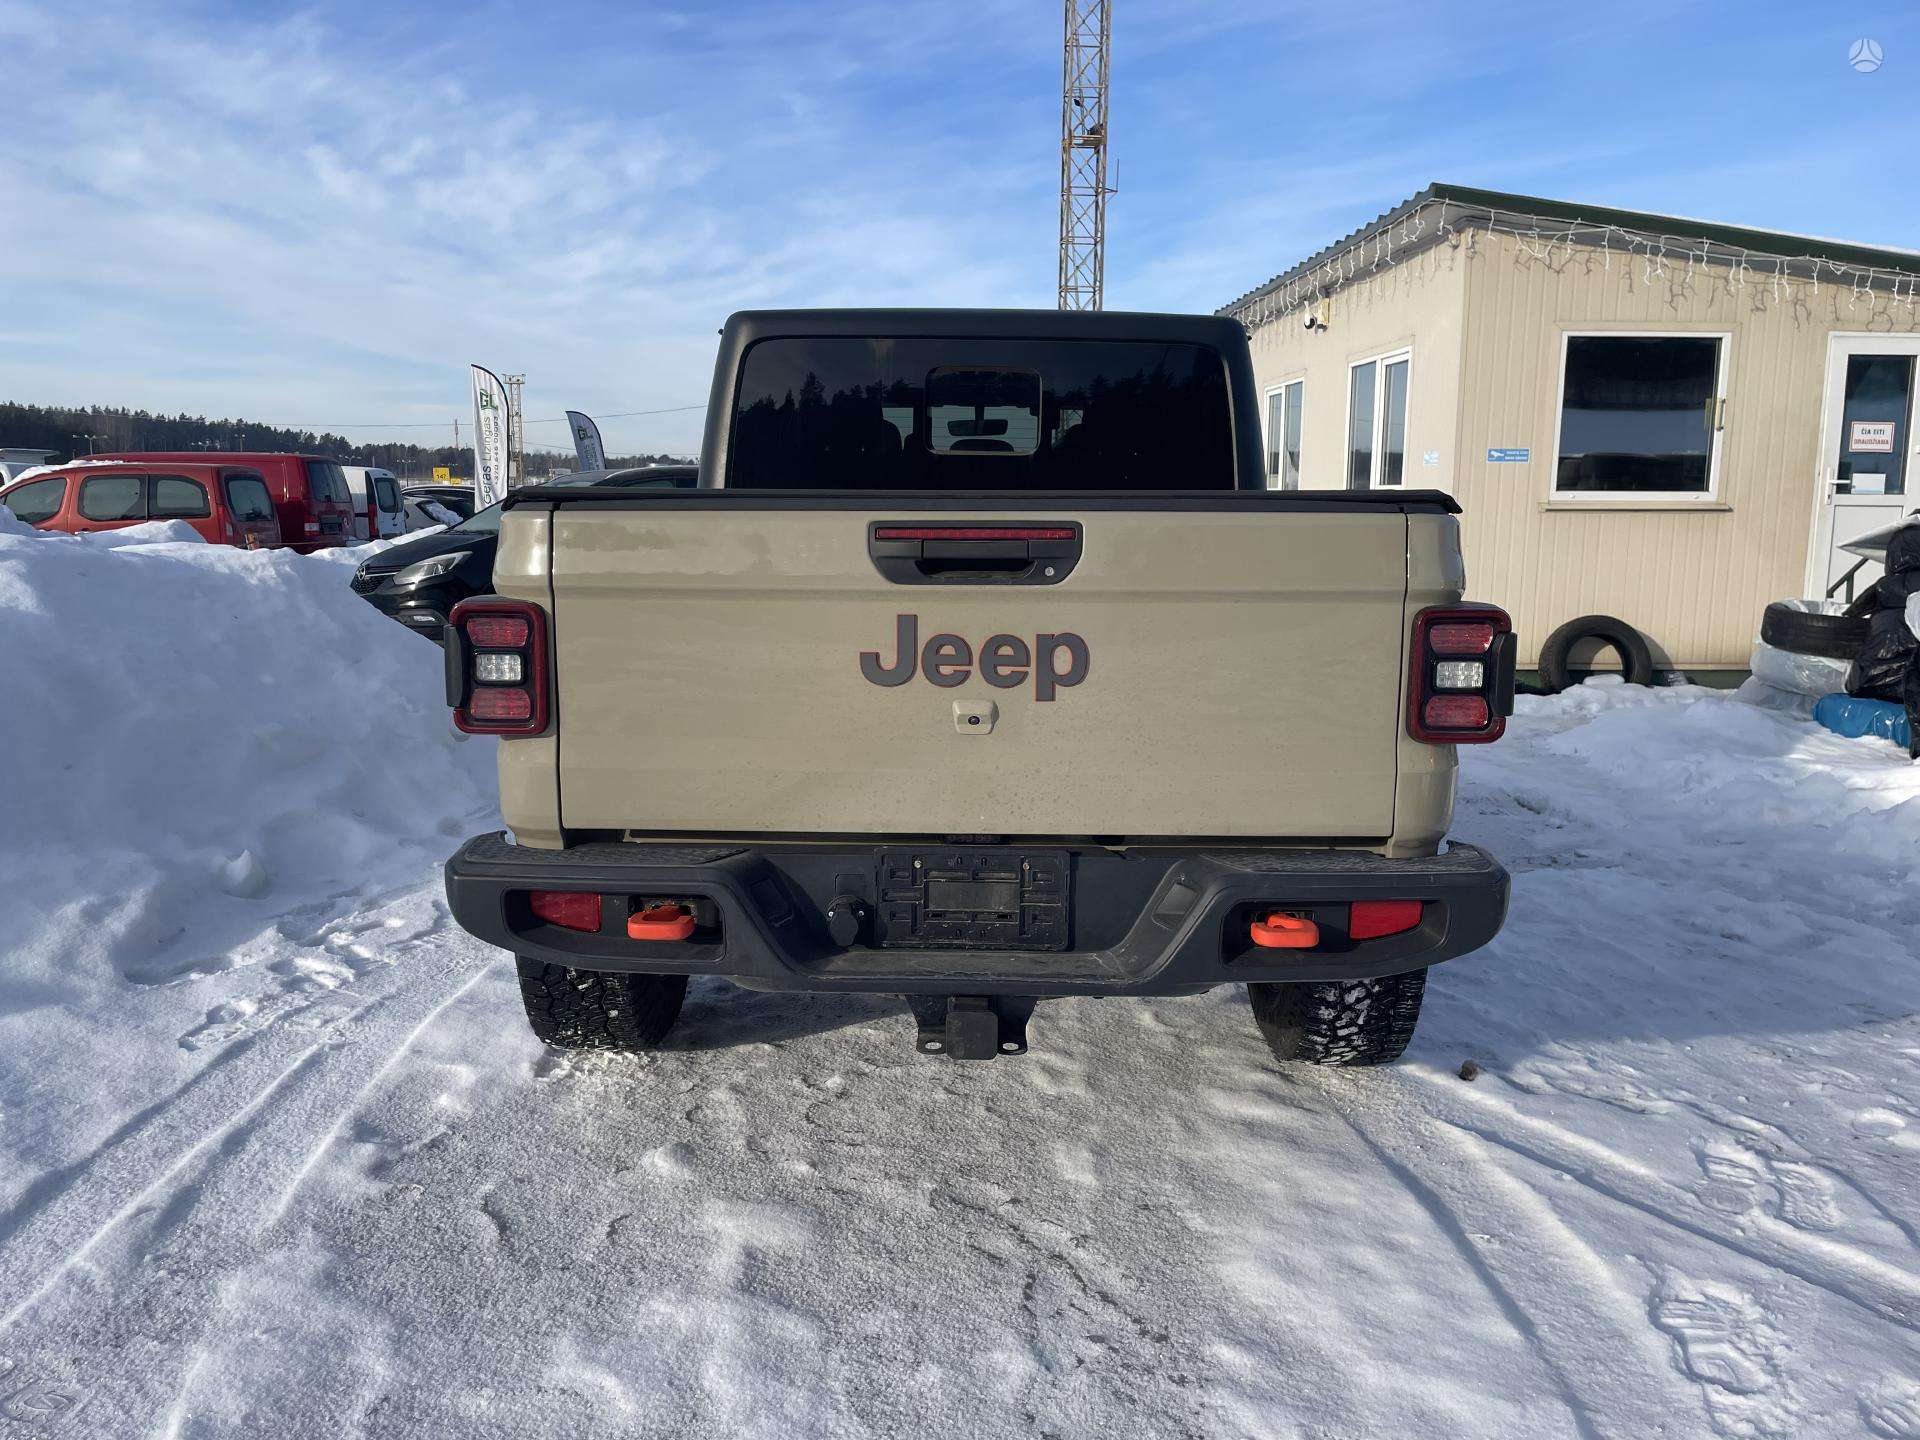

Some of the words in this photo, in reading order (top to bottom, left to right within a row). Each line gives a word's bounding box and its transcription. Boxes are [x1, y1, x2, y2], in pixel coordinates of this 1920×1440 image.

[482, 416, 493, 461] Lizingas
[482, 466, 492, 504] Geras
[859, 614, 1091, 702] Jeep
